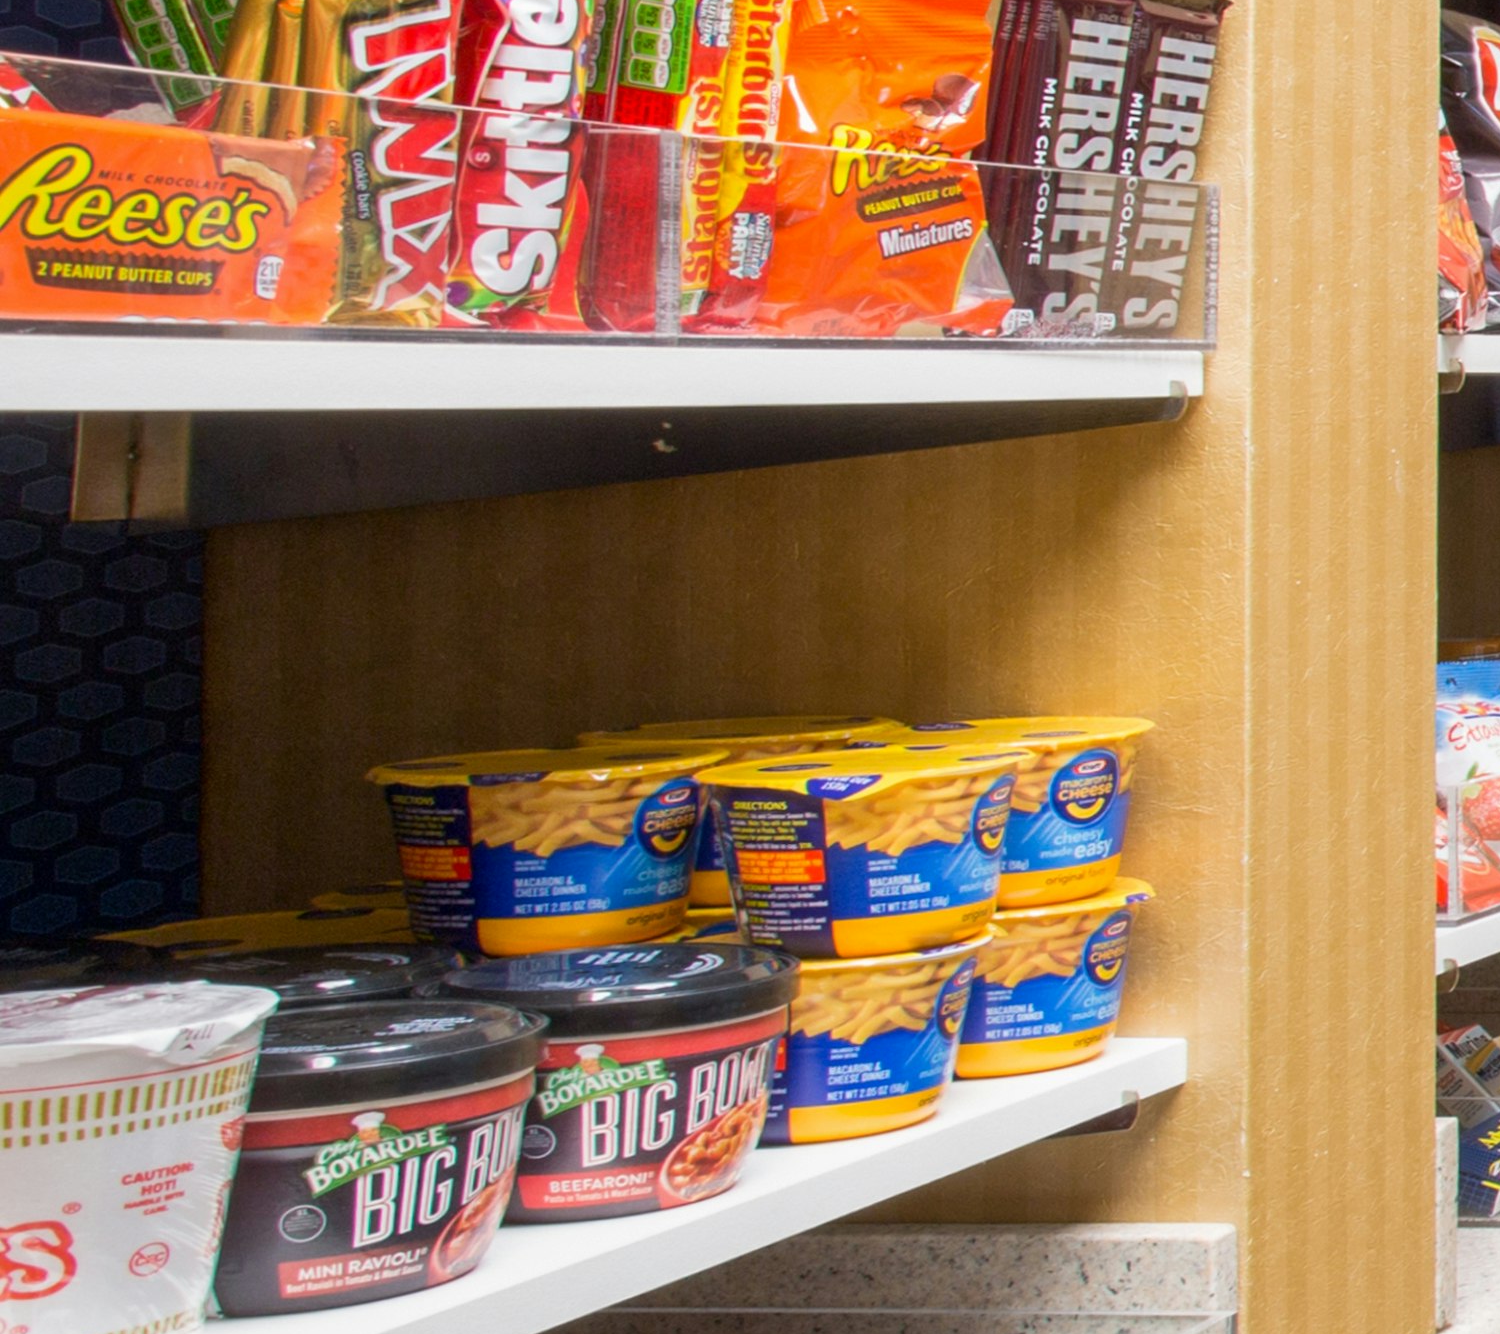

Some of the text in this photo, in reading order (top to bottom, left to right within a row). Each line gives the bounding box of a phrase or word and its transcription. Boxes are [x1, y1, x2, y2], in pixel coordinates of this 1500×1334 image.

[98, 169, 229, 192] MILK CHOCOLATE
[350, 151, 370, 219] cookie bars
[1027, 77, 1059, 267] MILK CHOCOLATE
[1042, 18, 1134, 327] HERSHEY'S
[1111, 92, 1145, 273] MILK CHOCOLATE
[1122, 35, 1218, 331] HERSHEY'S
[0, 141, 270, 255] Reese's
[864, 189, 940, 216] PEANUT BUTTER
[730, 212, 748, 280] PARTY
[879, 217, 974, 260] Miniatures
[36, 261, 213, 288] 2 PEANUT BUTTER CUPS
[1039, 838, 1113, 859] made easy
[1053, 828, 1104, 846] cheesy
[513, 876, 564, 888] MACARONI
[513, 883, 588, 899] CHEESE DINNER
[624, 884, 655, 897] made
[868, 876, 909, 888] MACARONI
[868, 881, 931, 898] CHEESE DINNER
[514, 900, 587, 915] NET WT 2.05 OZ
[869, 899, 920, 915] NET WT 2.05
[537, 1057, 668, 1116] BOYARDEE
[545, 1067, 581, 1090] Chef
[687, 1042, 770, 1135] BOW
[581, 1079, 678, 1168] BIG
[306, 1125, 449, 1193] BOYARDEE
[316, 1138, 357, 1165] Chef
[121, 1161, 195, 1186] CAUTION:
[140, 1178, 178, 1196] HOT!
[549, 1170, 649, 1194] BEEFARONI
[352, 1145, 458, 1249] BIG
[575, 1189, 602, 1203] Tomato
[297, 1248, 421, 1282] MINI RAVIOLI
[306, 1277, 334, 1292] Ravioli
[344, 1272, 373, 1287] Tomato
